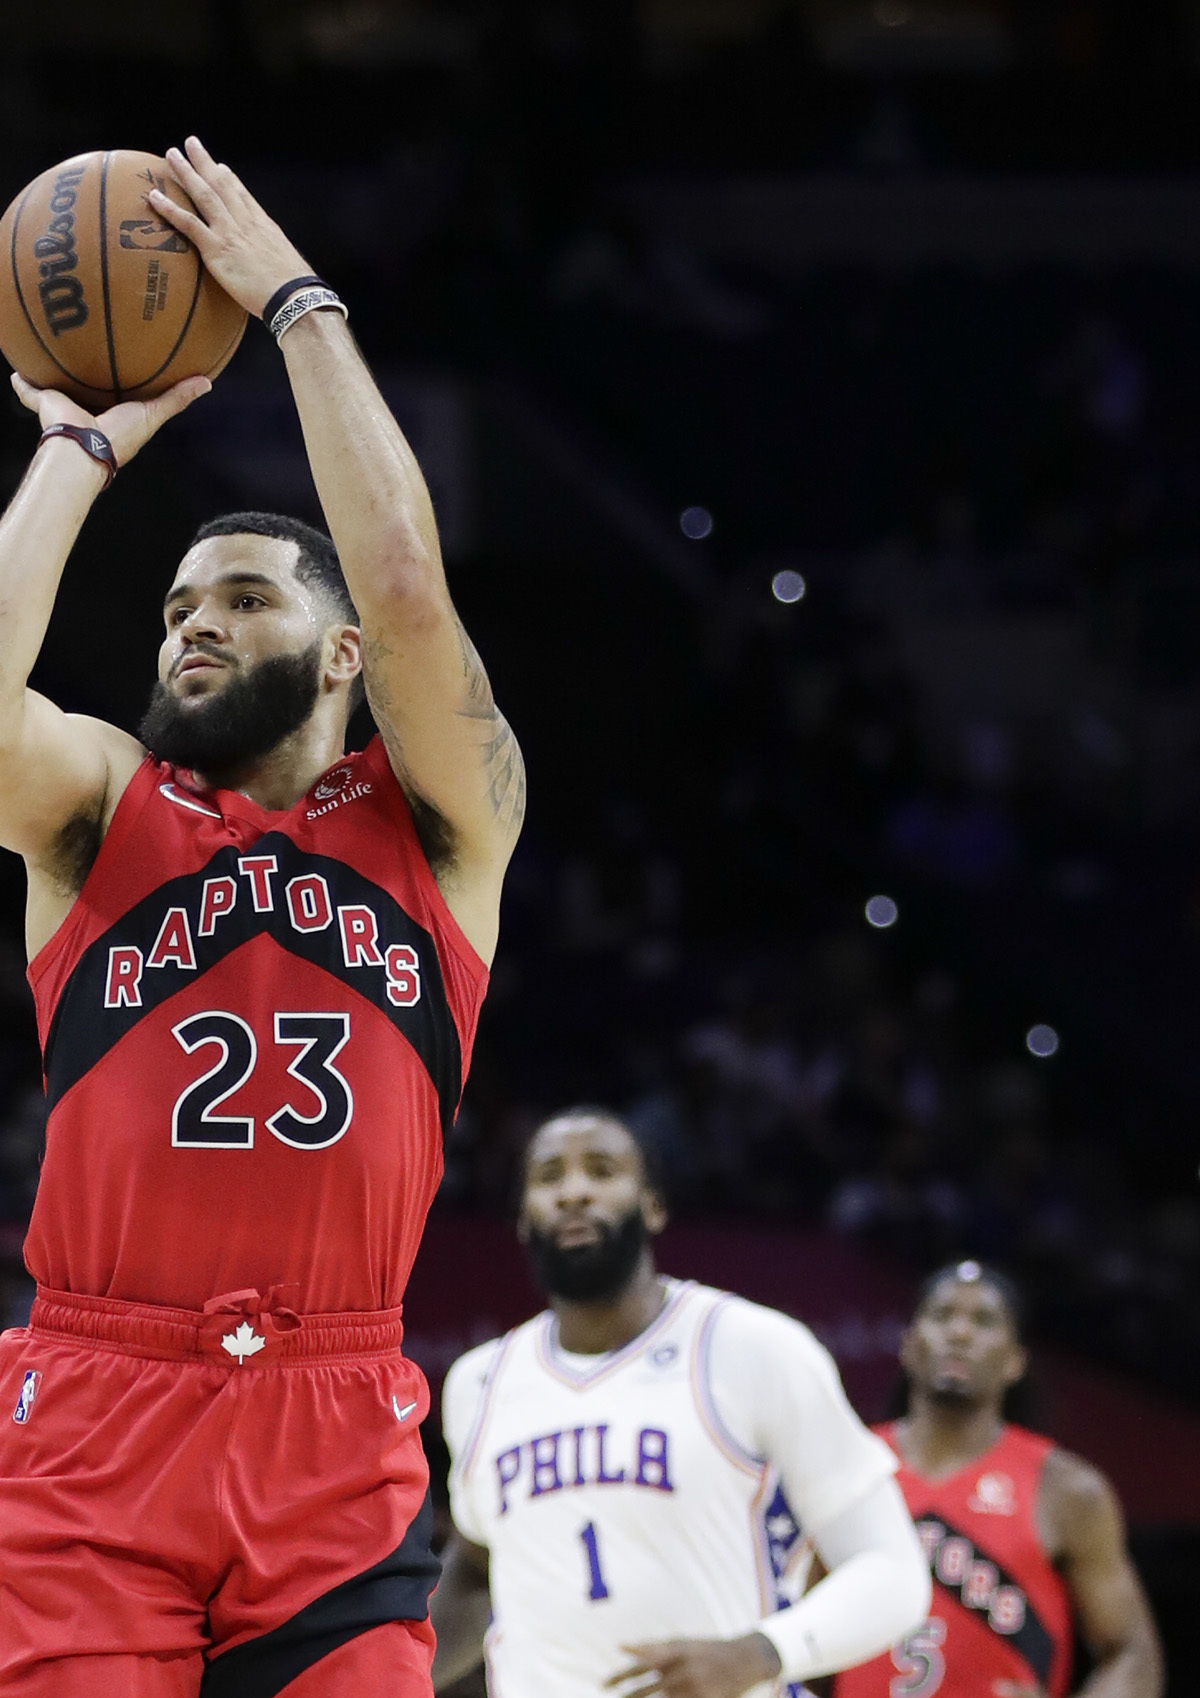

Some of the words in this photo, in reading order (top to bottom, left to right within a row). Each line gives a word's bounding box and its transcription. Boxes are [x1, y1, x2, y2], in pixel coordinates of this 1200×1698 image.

[34, 166, 88, 338] Wilson
[305, 800, 339, 821] Sun
[341, 781, 373, 804] Life
[104, 855, 421, 1008] RAPTORS
[171, 1010, 354, 1150] 23
[496, 1424, 674, 1516] PHILA
[580, 1521, 609, 1601] 1
